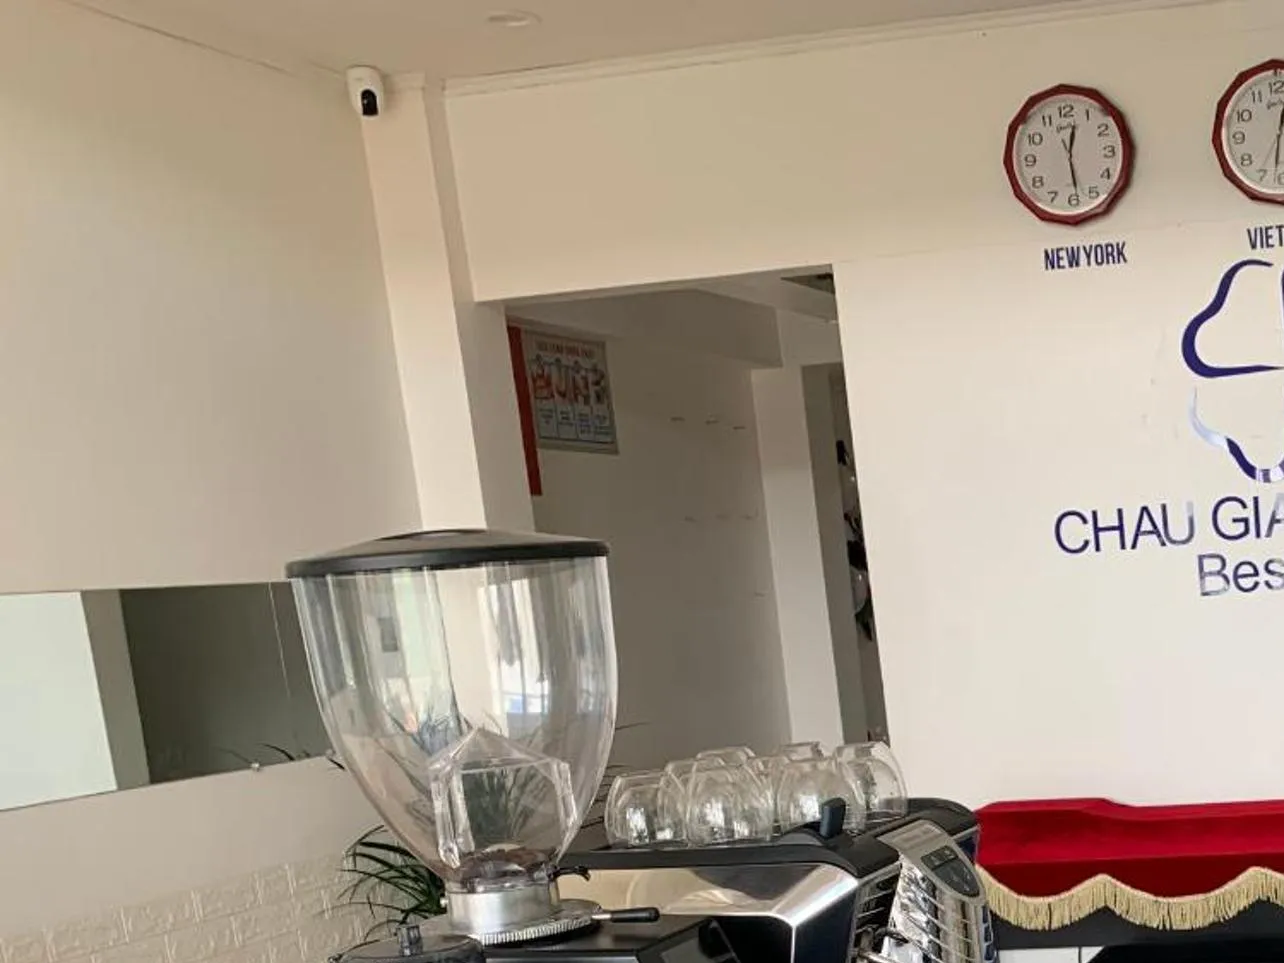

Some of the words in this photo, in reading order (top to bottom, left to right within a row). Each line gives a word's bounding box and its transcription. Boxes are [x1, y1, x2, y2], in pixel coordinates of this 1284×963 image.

[1252, 90, 1262, 103] 11
[1058, 104, 1074, 118] 12
[1236, 109, 1252, 123] 10
[1042, 114, 1052, 127] 11
[1097, 123, 1109, 137] 2
[1028, 132, 1043, 146] 10
[1232, 131, 1245, 145] 9
[1103, 145, 1116, 158] 3
[1024, 154, 1037, 167] 9
[1241, 153, 1253, 167] 8
[1100, 167, 1111, 180] 4
[1257, 169, 1267, 181] 7
[1032, 176, 1044, 189] 8
[1047, 191, 1058, 203] 7
[1088, 186, 1100, 199] 5
[1068, 193, 1080, 207] 6
[1054, 500, 1195, 554] CHAU
